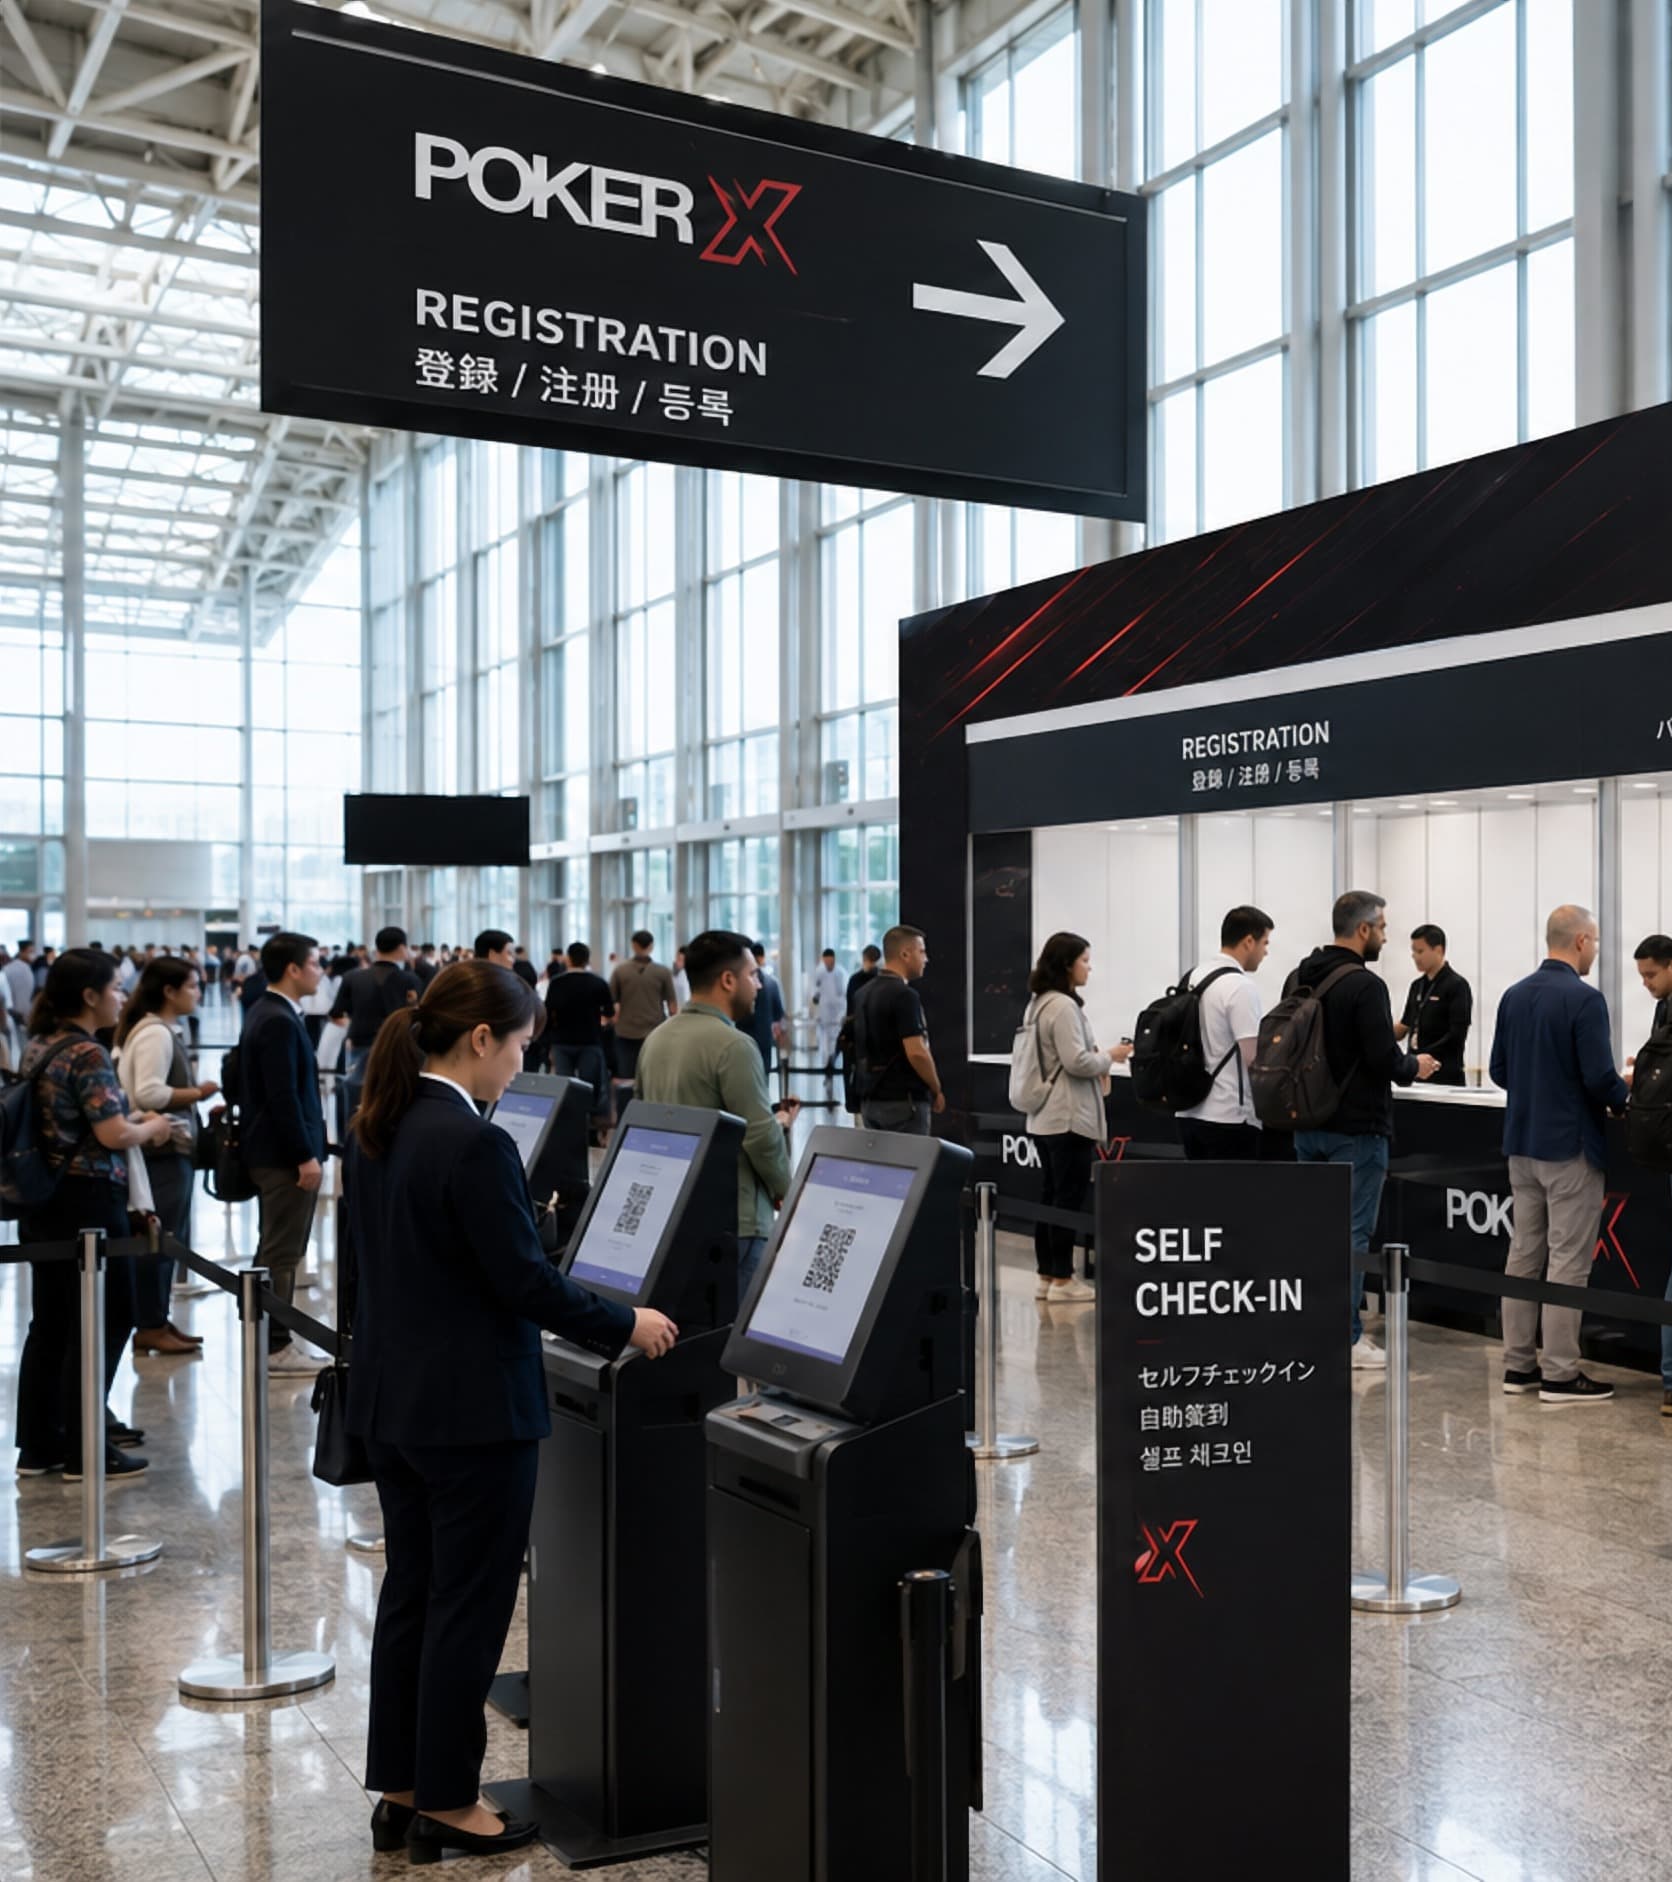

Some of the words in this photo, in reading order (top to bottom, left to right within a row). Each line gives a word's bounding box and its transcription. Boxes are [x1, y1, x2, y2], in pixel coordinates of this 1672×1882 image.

[416, 288, 767, 377] REGISTRATION
[415, 348, 498, 394] 登録
[540, 366, 619, 411] 注册
[659, 383, 734, 427] 등록
[1182, 720, 1330, 760] REGISTRATION
[1135, 1227, 1223, 1264] SELF
[1135, 1278, 1302, 1317] CHECK-IN
[1138, 1360, 1316, 1388] セルフチェックイン
[1189, 1440, 1252, 1468] 체크인
